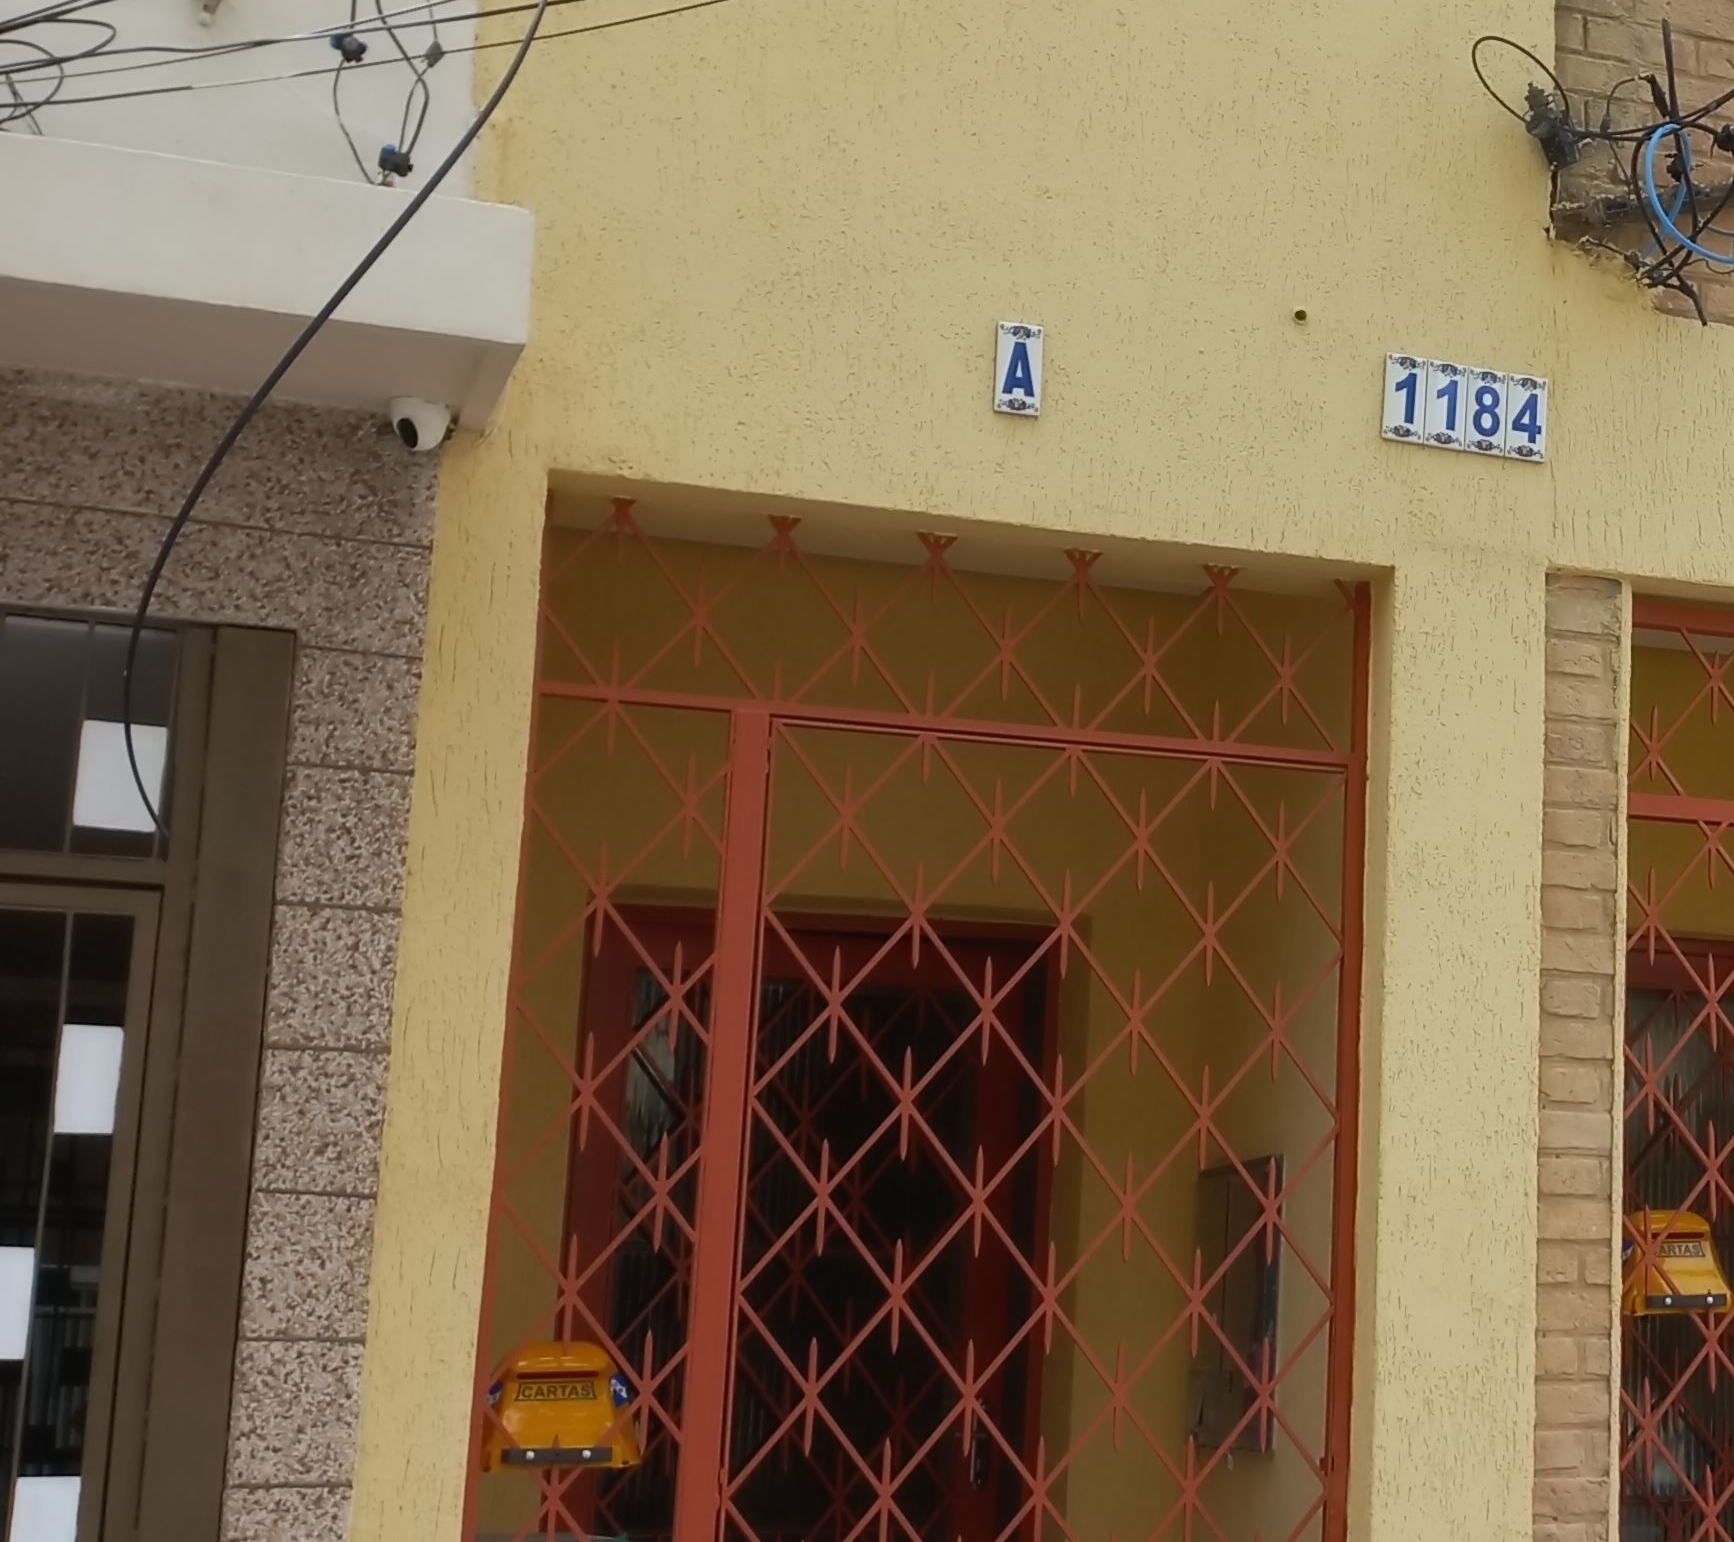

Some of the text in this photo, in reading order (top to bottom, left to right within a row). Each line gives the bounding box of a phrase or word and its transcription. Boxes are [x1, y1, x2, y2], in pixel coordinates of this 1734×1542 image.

[1001, 341, 1035, 398] A
[1394, 372, 1543, 445] 1184
[1658, 1244, 1700, 1255] ARTAS
[521, 1385, 592, 1399] CARTAS
